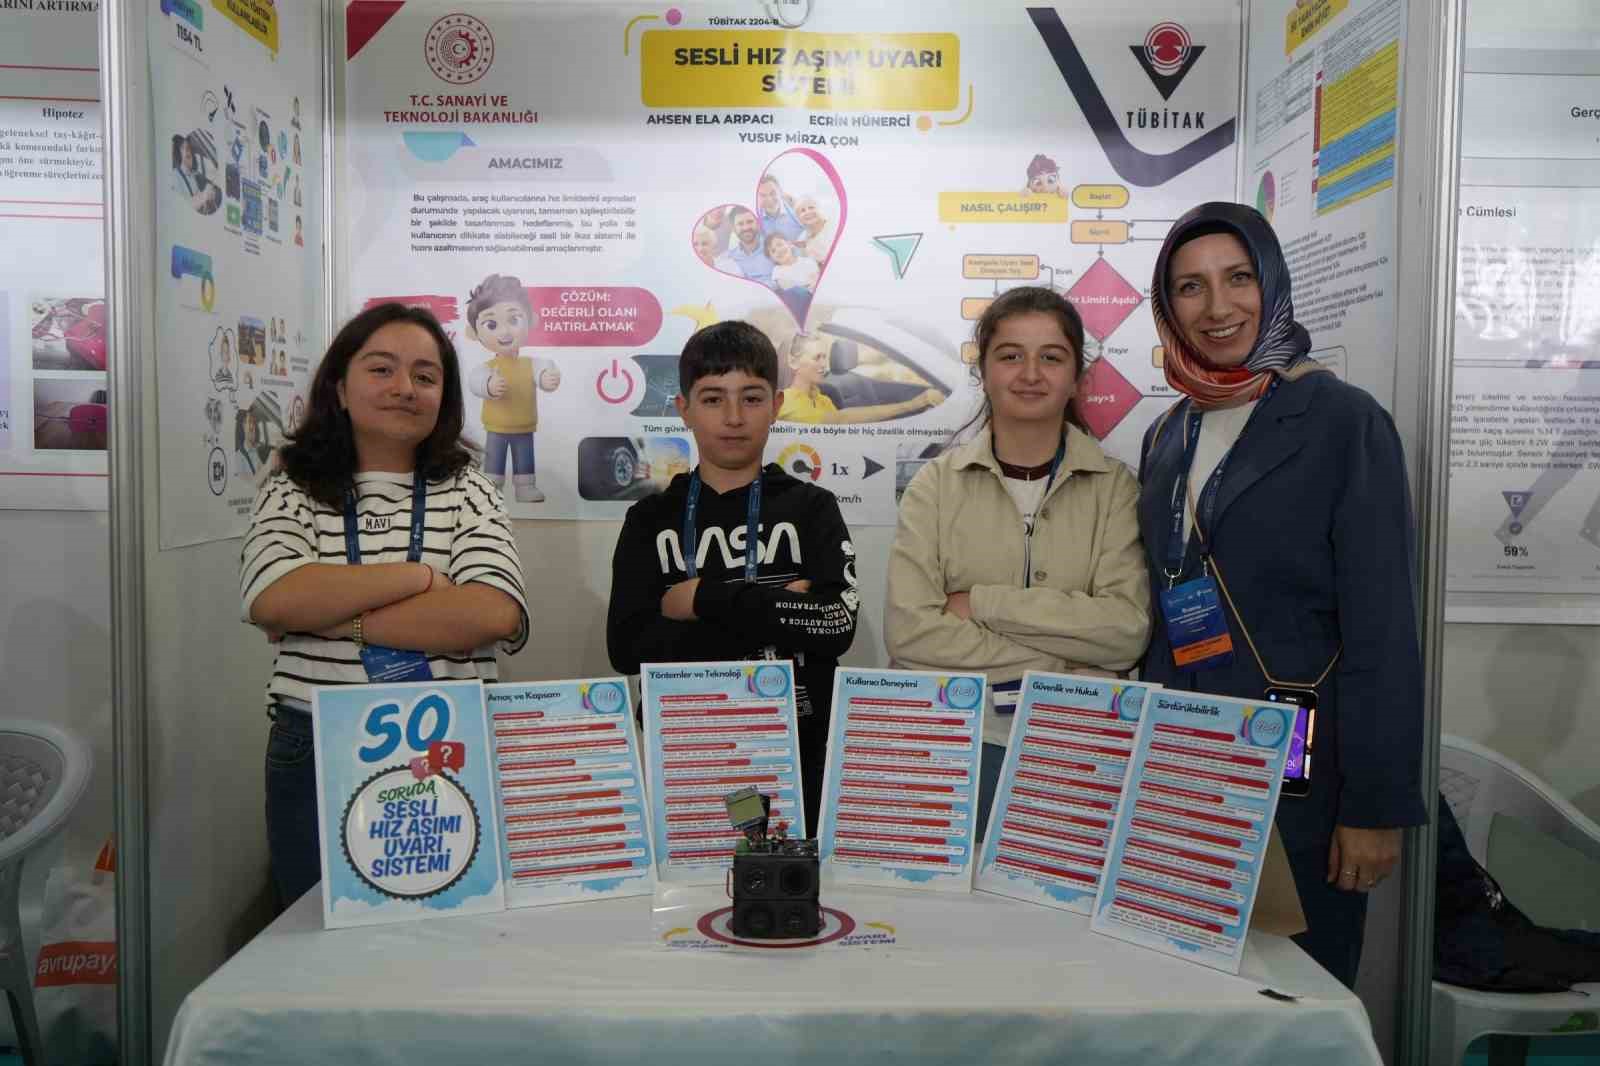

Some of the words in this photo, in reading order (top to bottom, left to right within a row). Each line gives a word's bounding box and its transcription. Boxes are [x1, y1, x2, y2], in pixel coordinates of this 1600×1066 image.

[0, 0, 33, 9] RINI
[708, 16, 746, 25] TÜBİTAK
[749, 17, 779, 25] 2204-B
[176, 23, 193, 45] 1154
[193, 34, 203, 52] TL
[674, 43, 739, 66] SESLİ
[747, 48, 787, 65] HIZ
[793, 50, 861, 72] AŞIM
[870, 51, 942, 68] UYARI
[409, 95, 436, 107] T.C.
[436, 91, 487, 107] SANAYİ
[490, 95, 508, 107] VE
[42, 107, 85, 120] Hipotez
[384, 108, 460, 123] TEKNOLOJİ
[462, 108, 538, 123] BAKANLIĞI
[646, 115, 692, 125] AHSEN
[695, 115, 720, 125] ELA
[724, 114, 774, 125] ARPACI
[1126, 108, 1205, 129] TÜBİTAK
[809, 113, 848, 127] ECRİN
[851, 113, 911, 128] HÜNERCİ
[738, 132, 782, 144] YUSUF
[785, 131, 826, 146] MİRZA
[830, 136, 859, 149] ÇON
[488, 158, 563, 169] AMACIMIZ
[413, 193, 425, 201] Bu
[960, 203, 995, 212] NASIL
[998, 203, 1049, 215] ÇALIŞIR?
[1466, 205, 1517, 218] Cümlesi
[411, 218, 422, 226] bir
[560, 289, 612, 304] ÇÖZÜM:
[541, 305, 595, 318] DEĞERLİ
[597, 307, 637, 318] OLANI
[543, 321, 635, 333] HATIRLATMAK
[643, 424, 663, 433] Tüm
[798, 427, 809, 435] ya
[810, 426, 821, 434] da
[823, 426, 846, 436] böyle
[832, 463, 849, 475] 1x
[656, 521, 803, 575] NASA
[806, 624, 850, 635] NATIONAL
[650, 671, 691, 679] Yöntemler
[1075, 686, 1099, 697] Hukuk
[358, 694, 451, 763] 50
[377, 780, 437, 804] SORUDA
[383, 796, 438, 819] SESLİ
[369, 822, 401, 840] HIZ
[383, 836, 443, 858] UYARI
[371, 849, 452, 878] SİSTEMİ
[38, 952, 117, 977] avrupay
